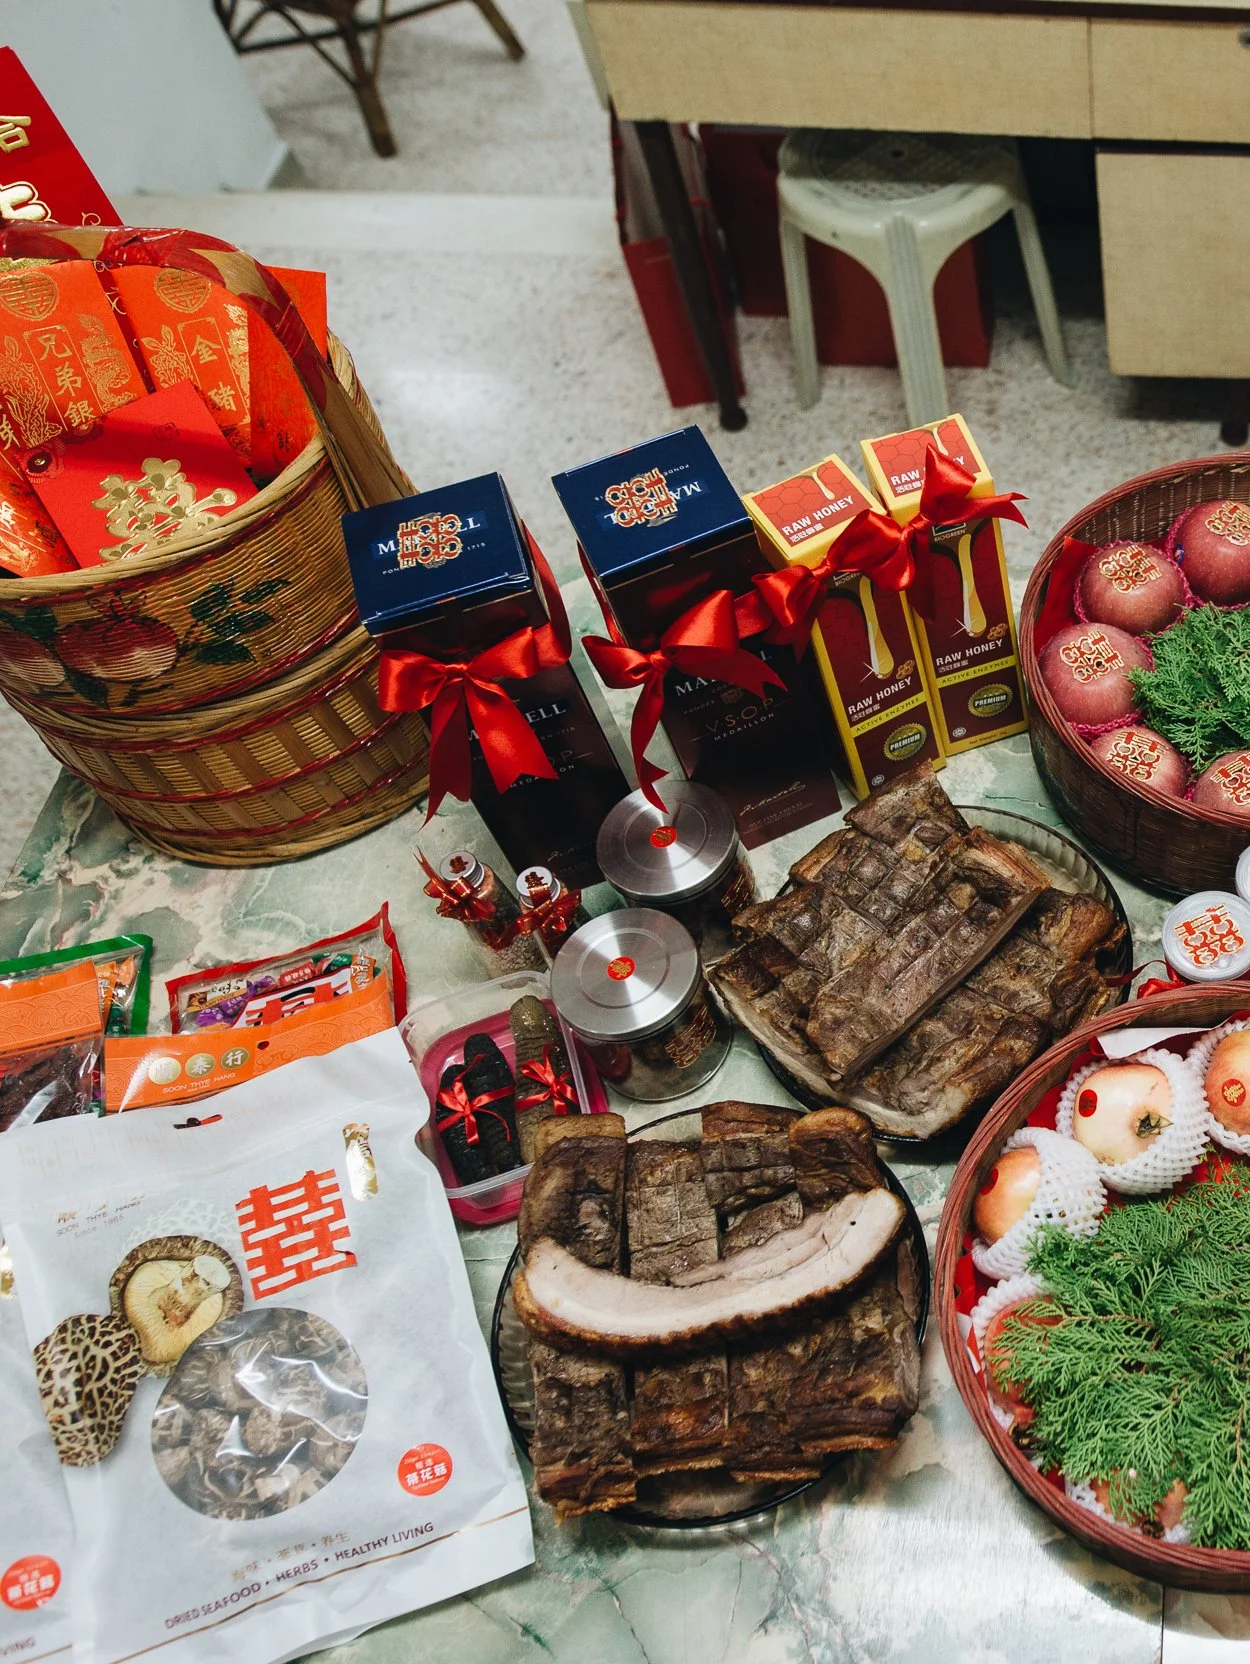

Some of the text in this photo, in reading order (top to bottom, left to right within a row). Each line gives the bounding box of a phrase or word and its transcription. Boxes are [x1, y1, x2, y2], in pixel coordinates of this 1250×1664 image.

[890, 470, 920, 486] RAW
[782, 495, 854, 536] RAW HONEY
[936, 639, 1003, 666] RAW HONEY
[942, 659, 1009, 684] ACTIVE ENZYMES
[848, 676, 912, 714] RAW HONEY
[974, 695, 1006, 707] PREMIUM
[714, 713, 775, 741] MEDAILLON
[856, 697, 919, 732] ACTIVE ENZYMES
[890, 733, 921, 750] PREMIUM
[163, 1084, 187, 1094] SOON
[188, 1079, 210, 1090] THYE
[214, 1072, 236, 1082] HANG
[165, 1522, 435, 1629] DRIED SEAFOOD HERBS HEALTHY LIVING
